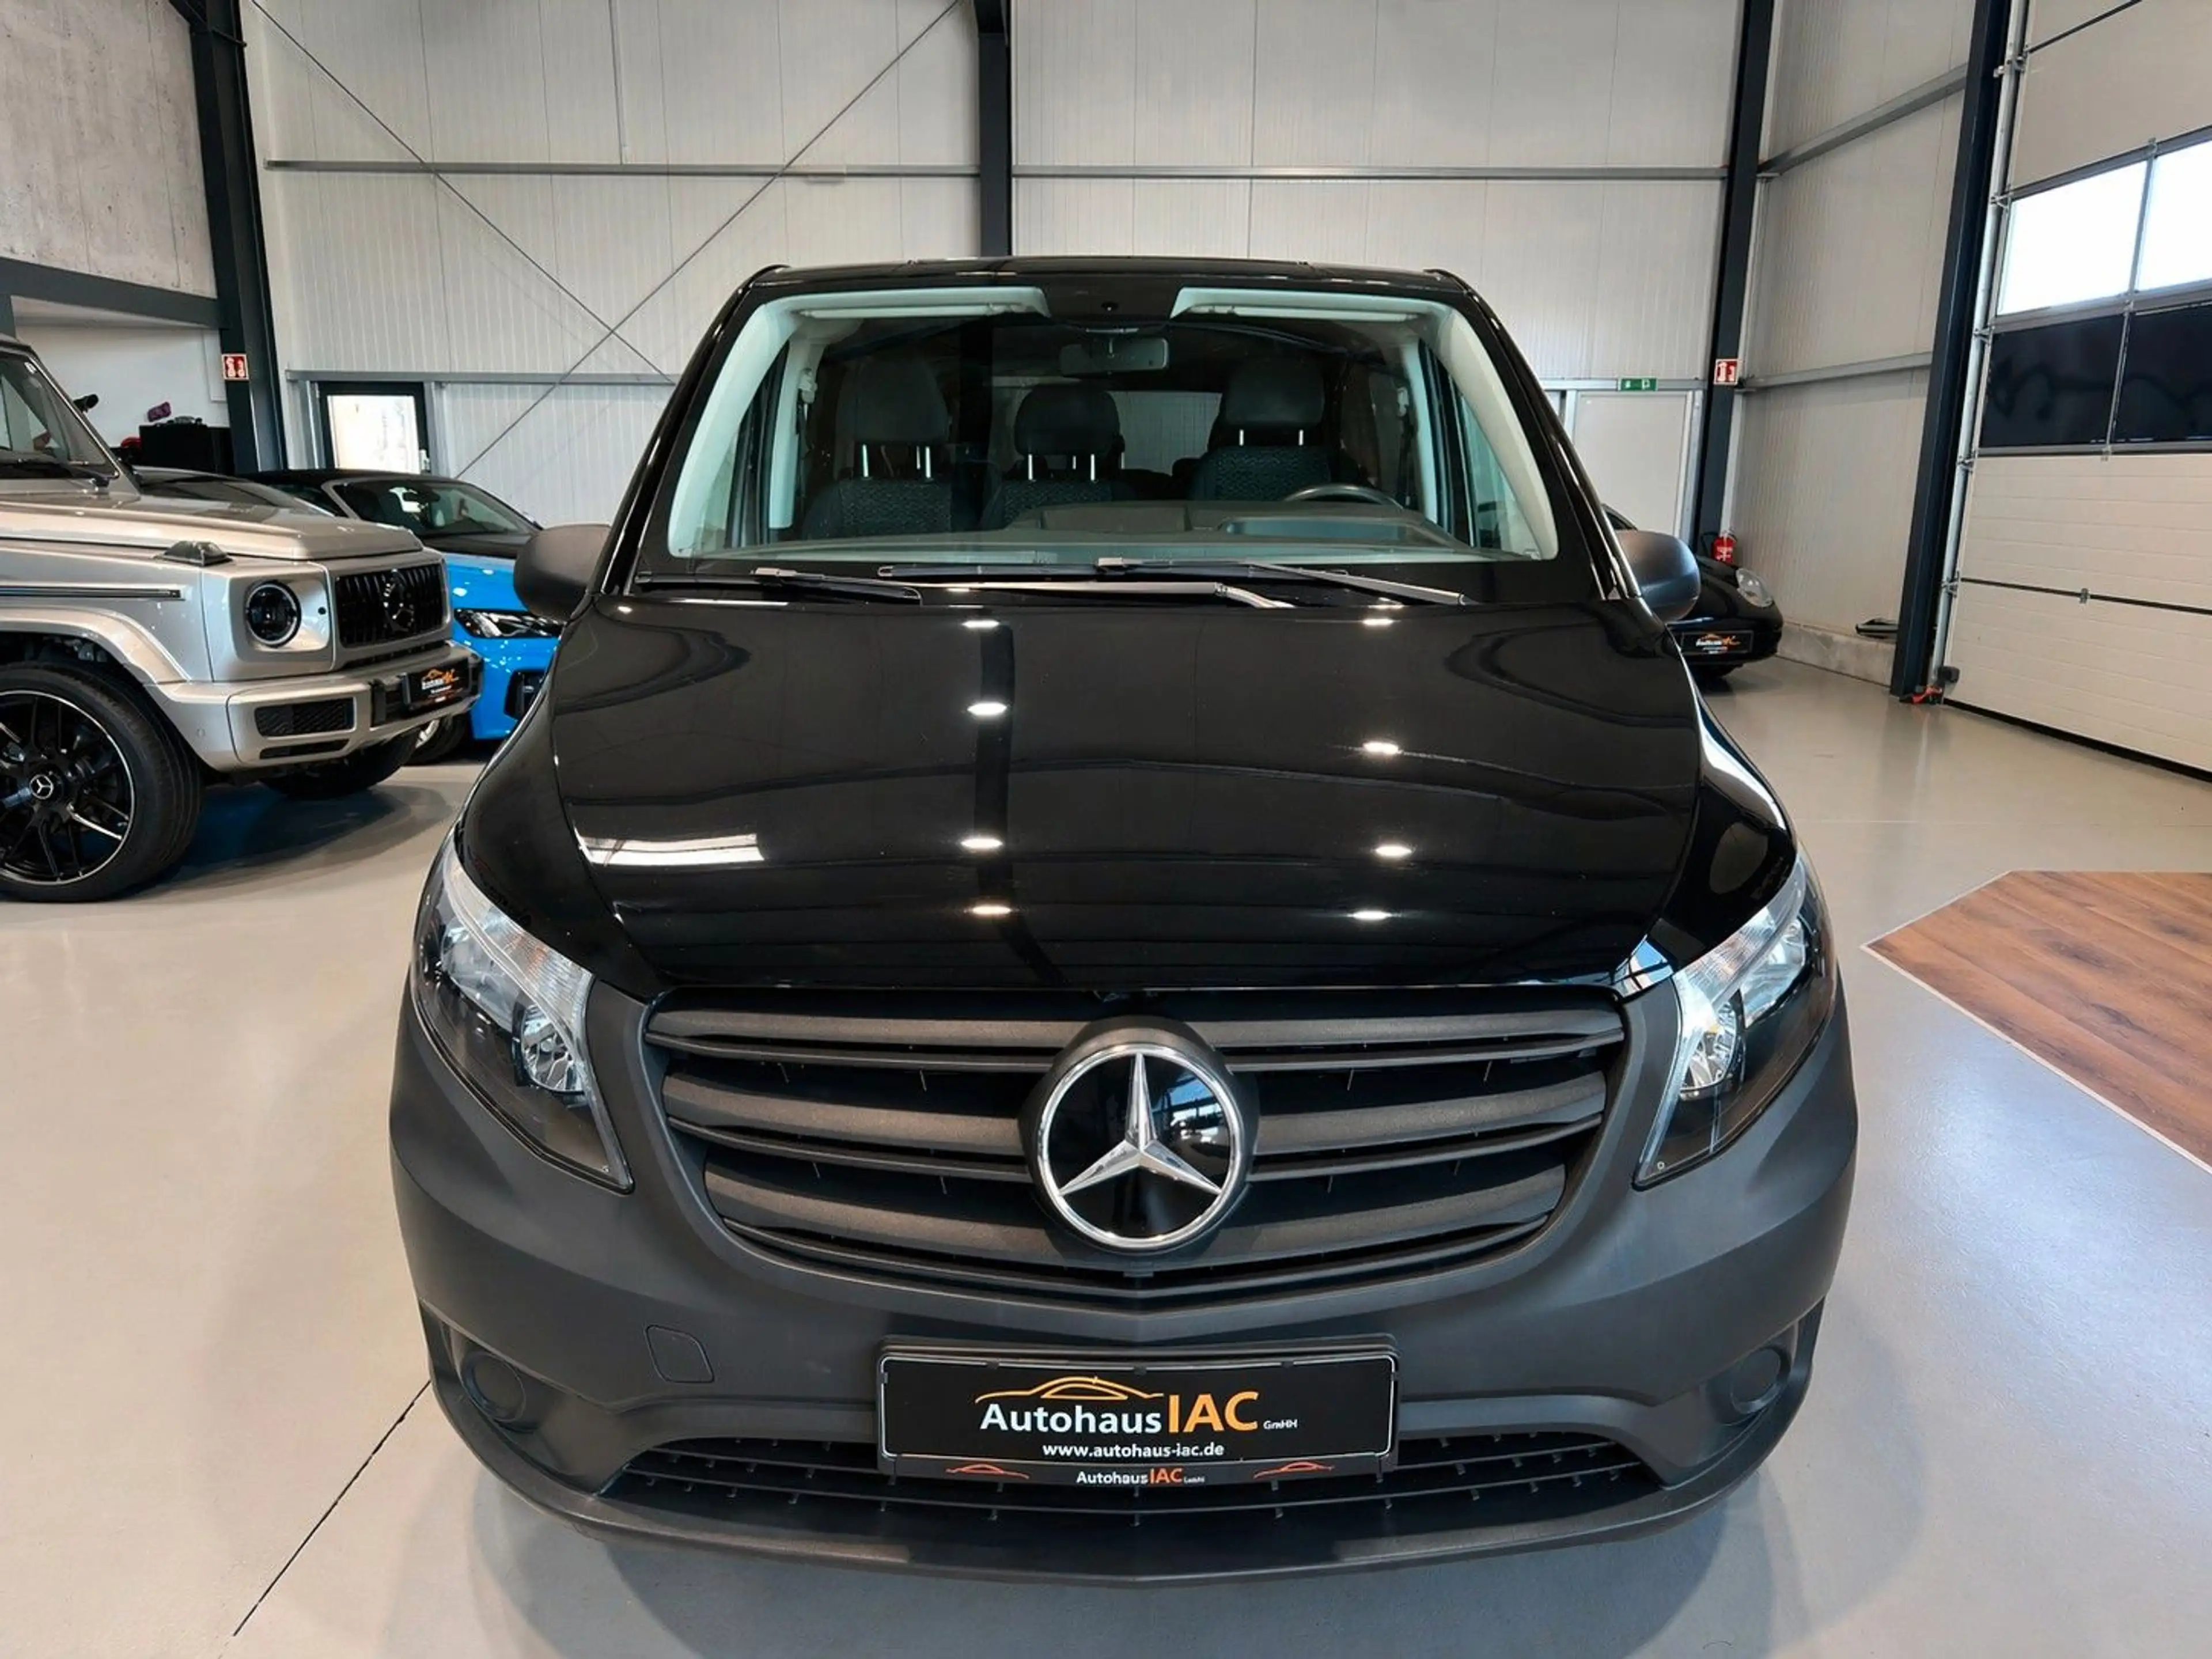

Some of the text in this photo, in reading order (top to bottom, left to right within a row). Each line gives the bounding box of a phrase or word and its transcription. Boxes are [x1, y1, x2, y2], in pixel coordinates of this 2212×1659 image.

[980, 1403, 1162, 1434] Autohaus
[1168, 1391, 1259, 1433] IAC
[1042, 1441, 1225, 1458] www.autohaus-iac.de
[1075, 1471, 1148, 1484] Autohaus
[1149, 1468, 1183, 1484] IAC
